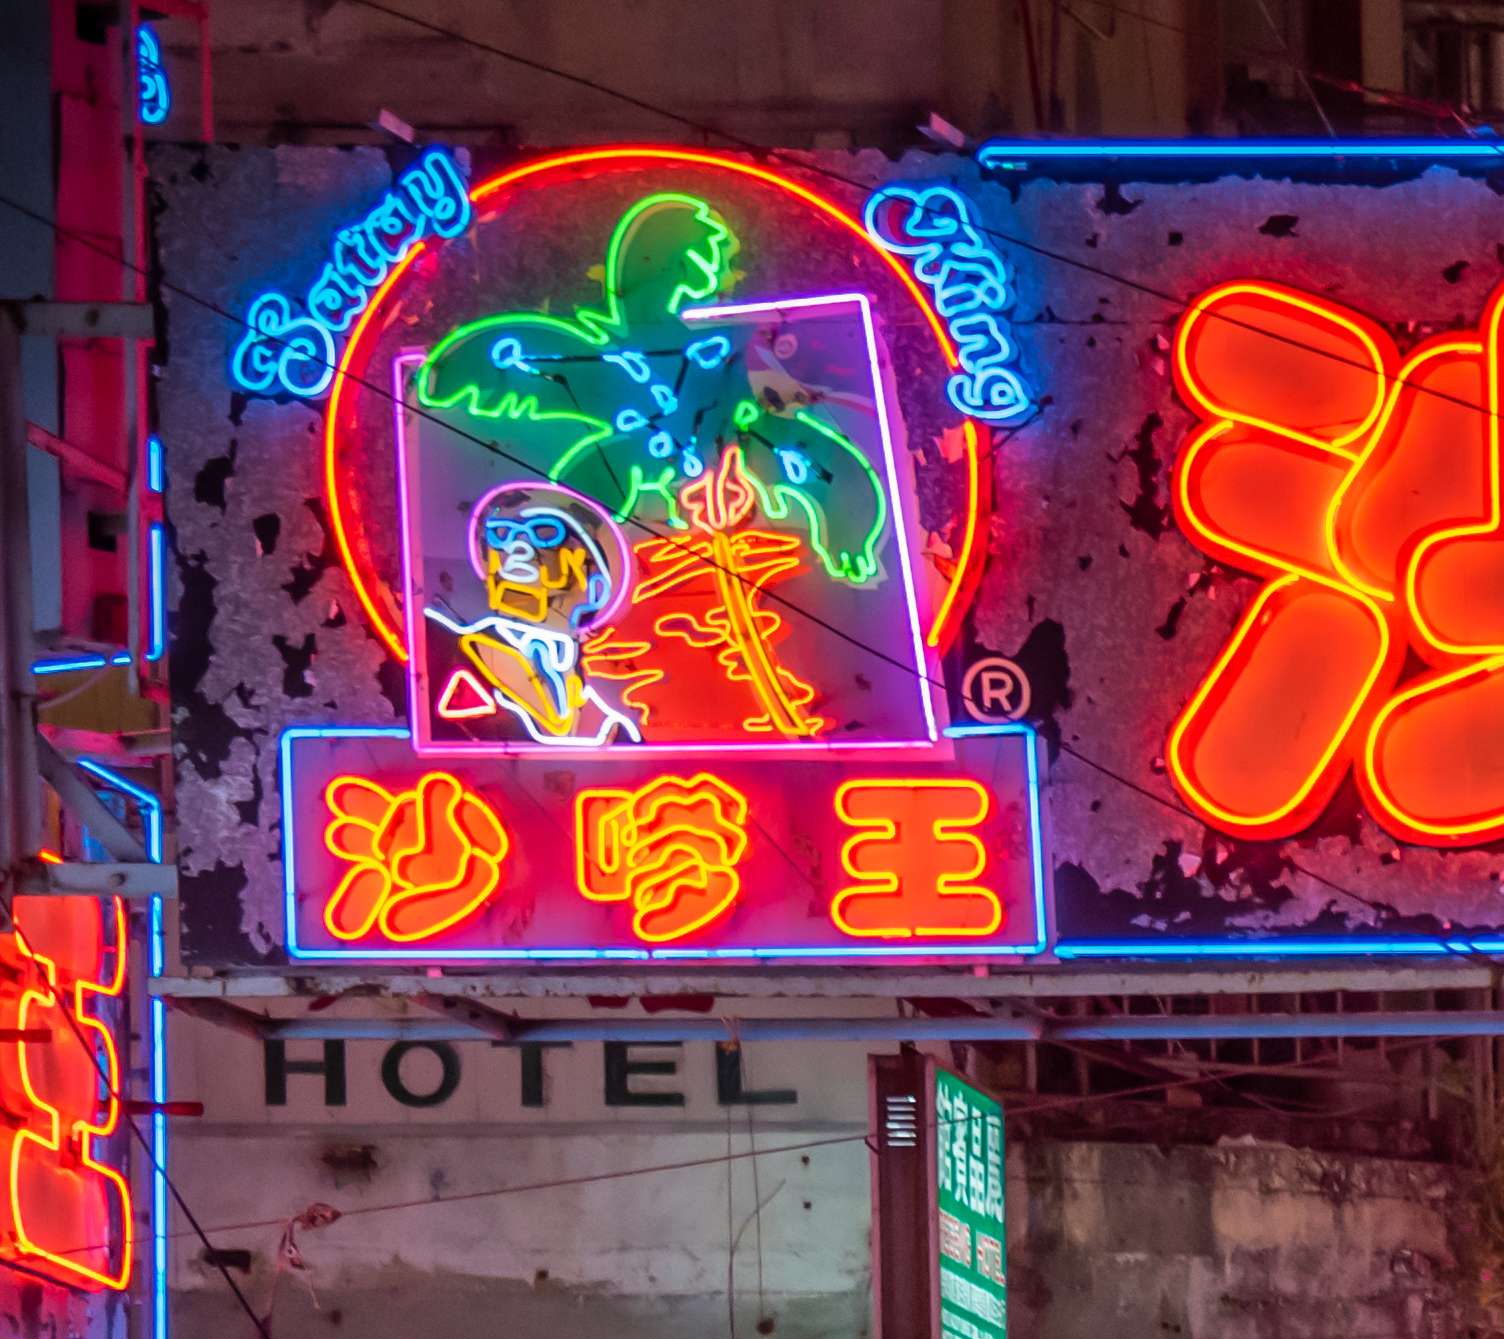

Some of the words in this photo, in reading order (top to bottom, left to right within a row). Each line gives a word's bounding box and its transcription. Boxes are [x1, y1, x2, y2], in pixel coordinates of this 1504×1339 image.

[230, 146, 472, 399] Satay
[864, 183, 1042, 427] King
[323, 770, 1004, 943] 沙嗲王
[264, 1038, 798, 1107] HOTEL
